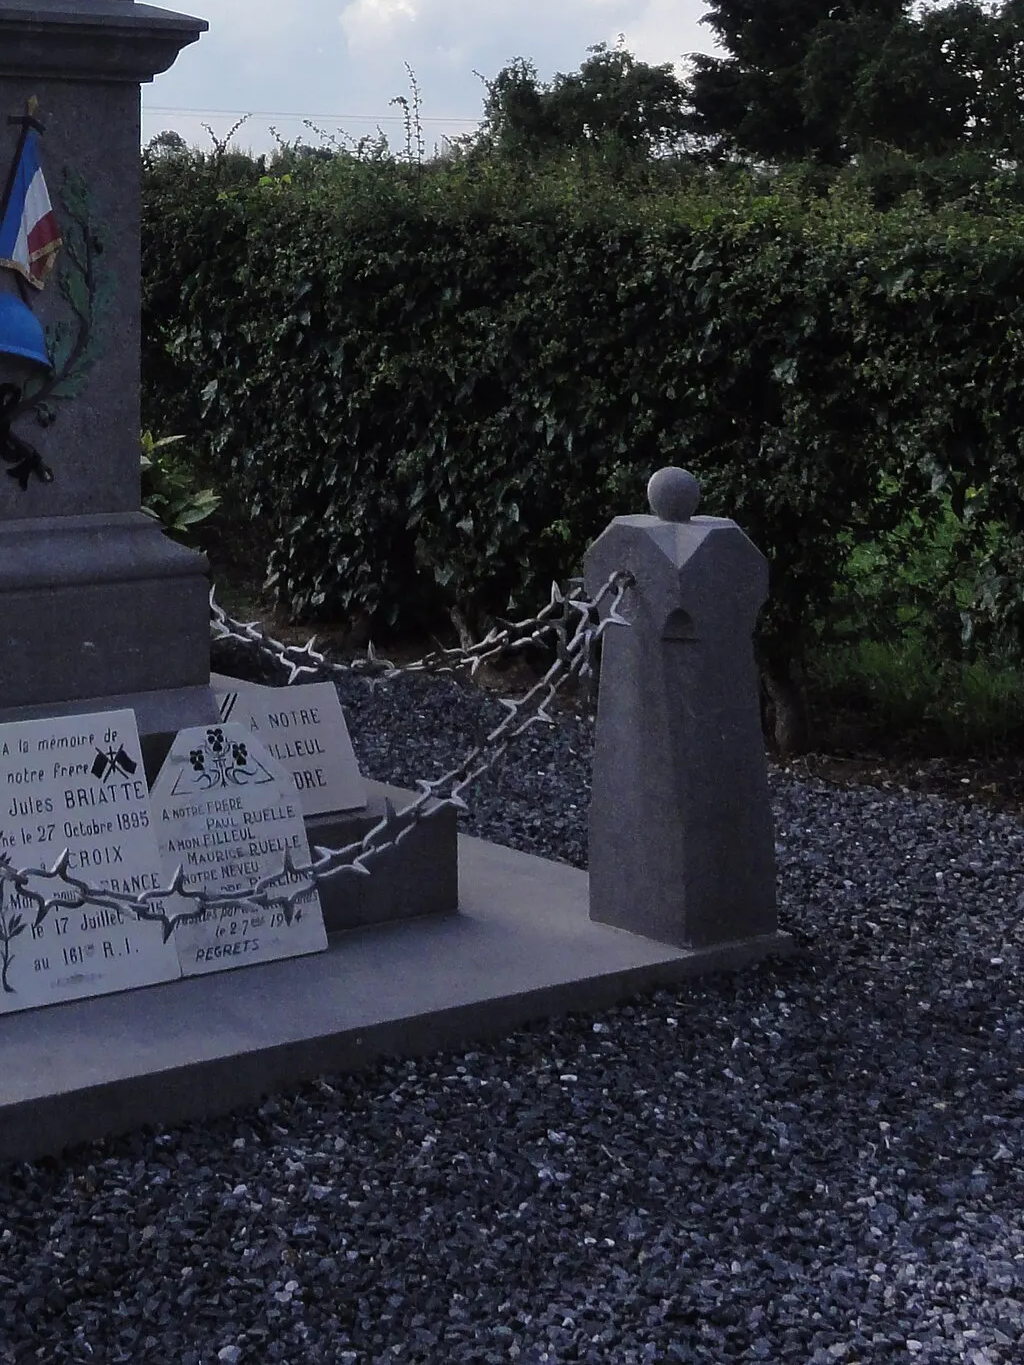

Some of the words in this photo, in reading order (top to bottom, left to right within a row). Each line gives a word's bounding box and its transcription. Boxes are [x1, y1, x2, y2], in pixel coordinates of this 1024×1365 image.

[268, 707, 321, 729] NOTRE
[2, 742, 10, 756] A
[19, 739, 29, 753] la
[38, 734, 95, 751] mémoire
[104, 728, 118, 743] de
[268, 739, 326, 760] ILLEUL
[7, 767, 45, 785] notre
[293, 769, 327, 790] DRE
[9, 796, 54, 817] Jules
[64, 780, 145, 809] BRIATTE
[161, 808, 170, 822] A
[172, 803, 205, 820] NOTRE
[206, 816, 236, 831] PAUL
[243, 805, 296, 825] RUELLE
[21, 827, 32, 845] le
[37, 824, 56, 842] 27
[63, 819, 113, 839] Octobre
[116, 810, 150, 831] 1895
[168, 839, 176, 852] A
[177, 835, 201, 851] MON
[204, 827, 257, 849] FILLEUL
[187, 847, 245, 866] MAURICE
[249, 834, 302, 857] RUELLE
[221, 860, 260, 880] NEVEU
[10, 892, 34, 911] Mor
[31, 922, 44, 940] le
[55, 917, 69, 935] 17
[80, 909, 125, 931] Juillet
[215, 924, 227, 938] le
[195, 938, 260, 963] REGRETS
[33, 956, 50, 971] au
